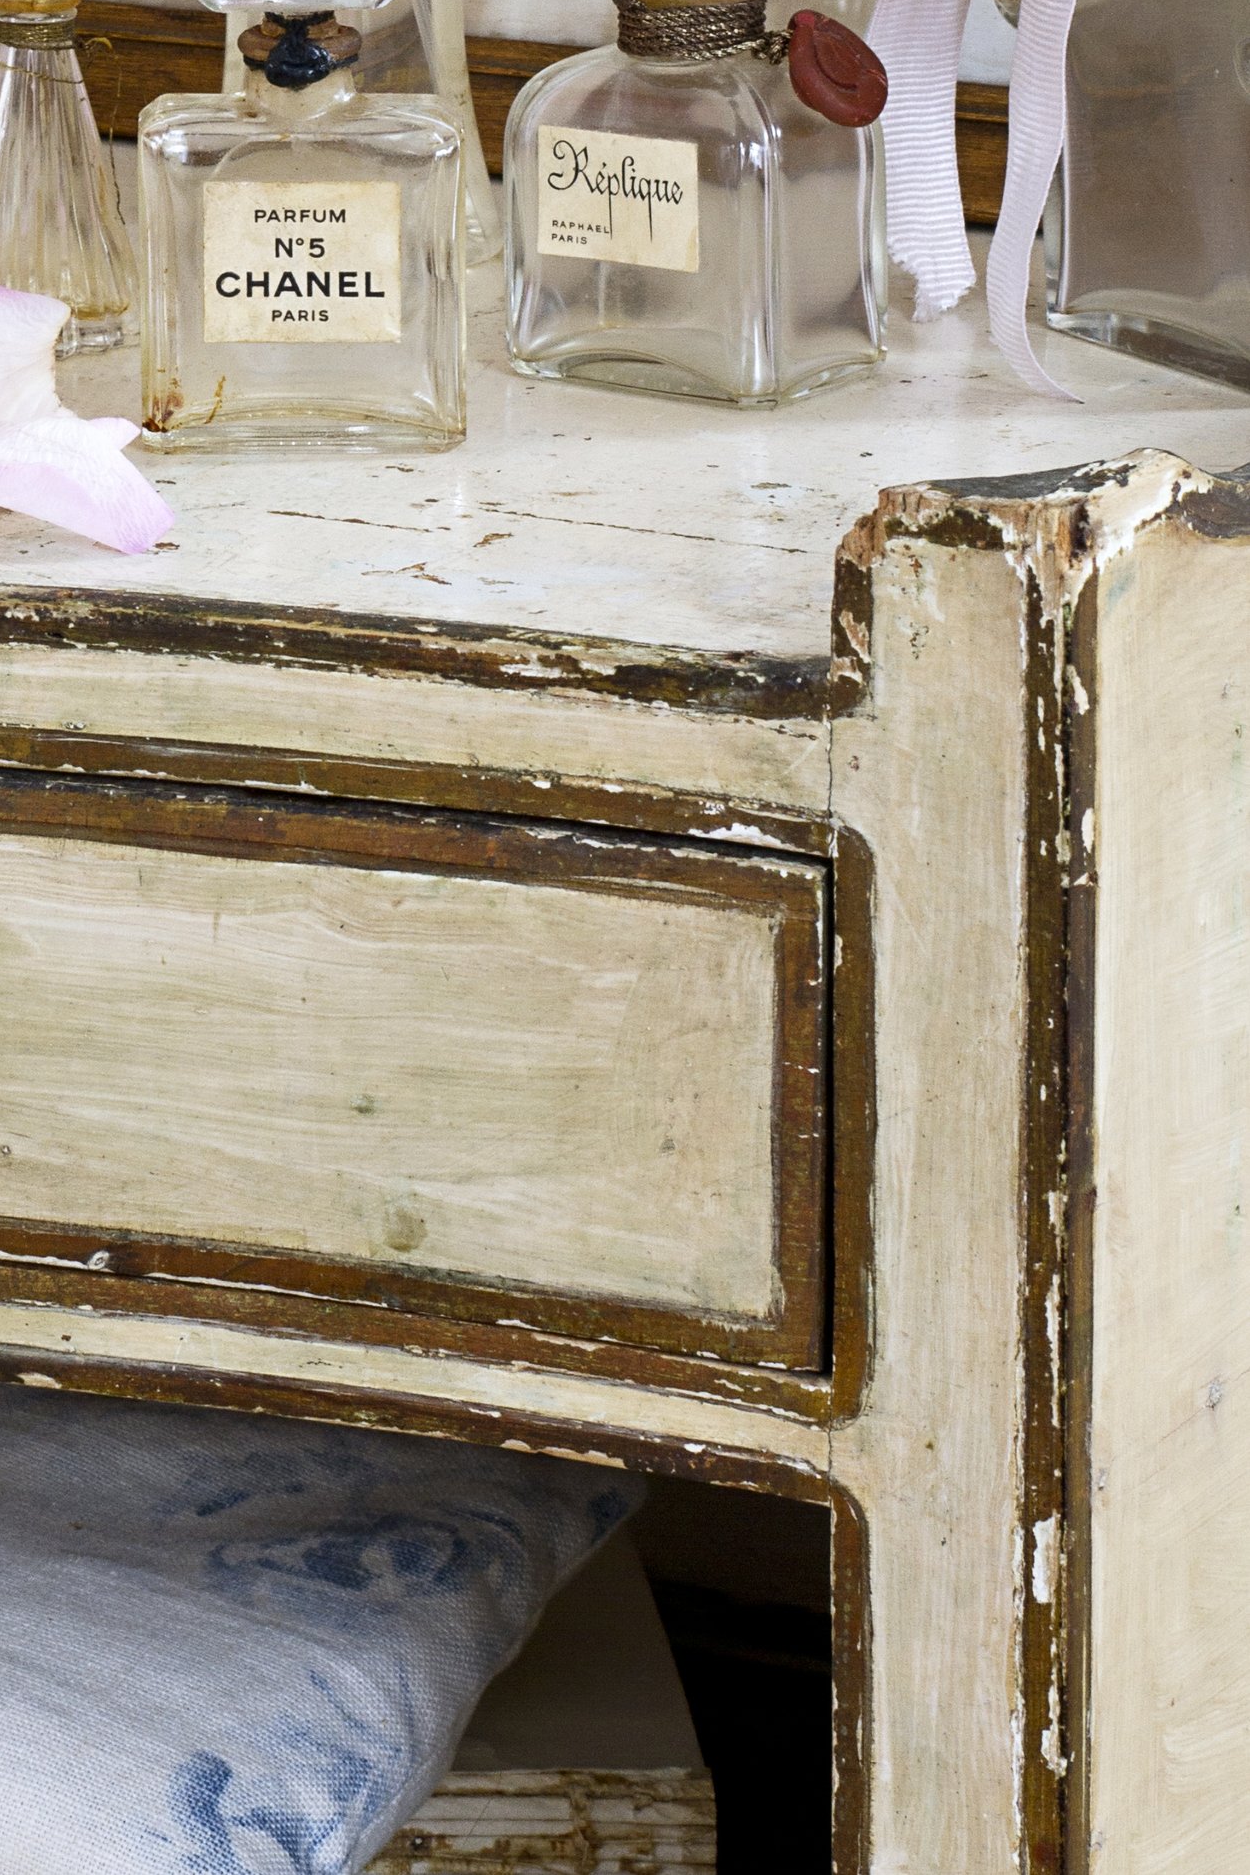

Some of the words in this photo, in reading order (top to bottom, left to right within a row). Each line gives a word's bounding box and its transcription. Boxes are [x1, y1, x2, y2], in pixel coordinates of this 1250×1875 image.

[547, 140, 683, 242] Réplique
[254, 209, 347, 223] PARFUM
[551, 219, 610, 235] RAPHAEL
[551, 233, 588, 245] PARIS
[215, 271, 385, 298] CHANEL
[271, 309, 330, 323] PARIS
